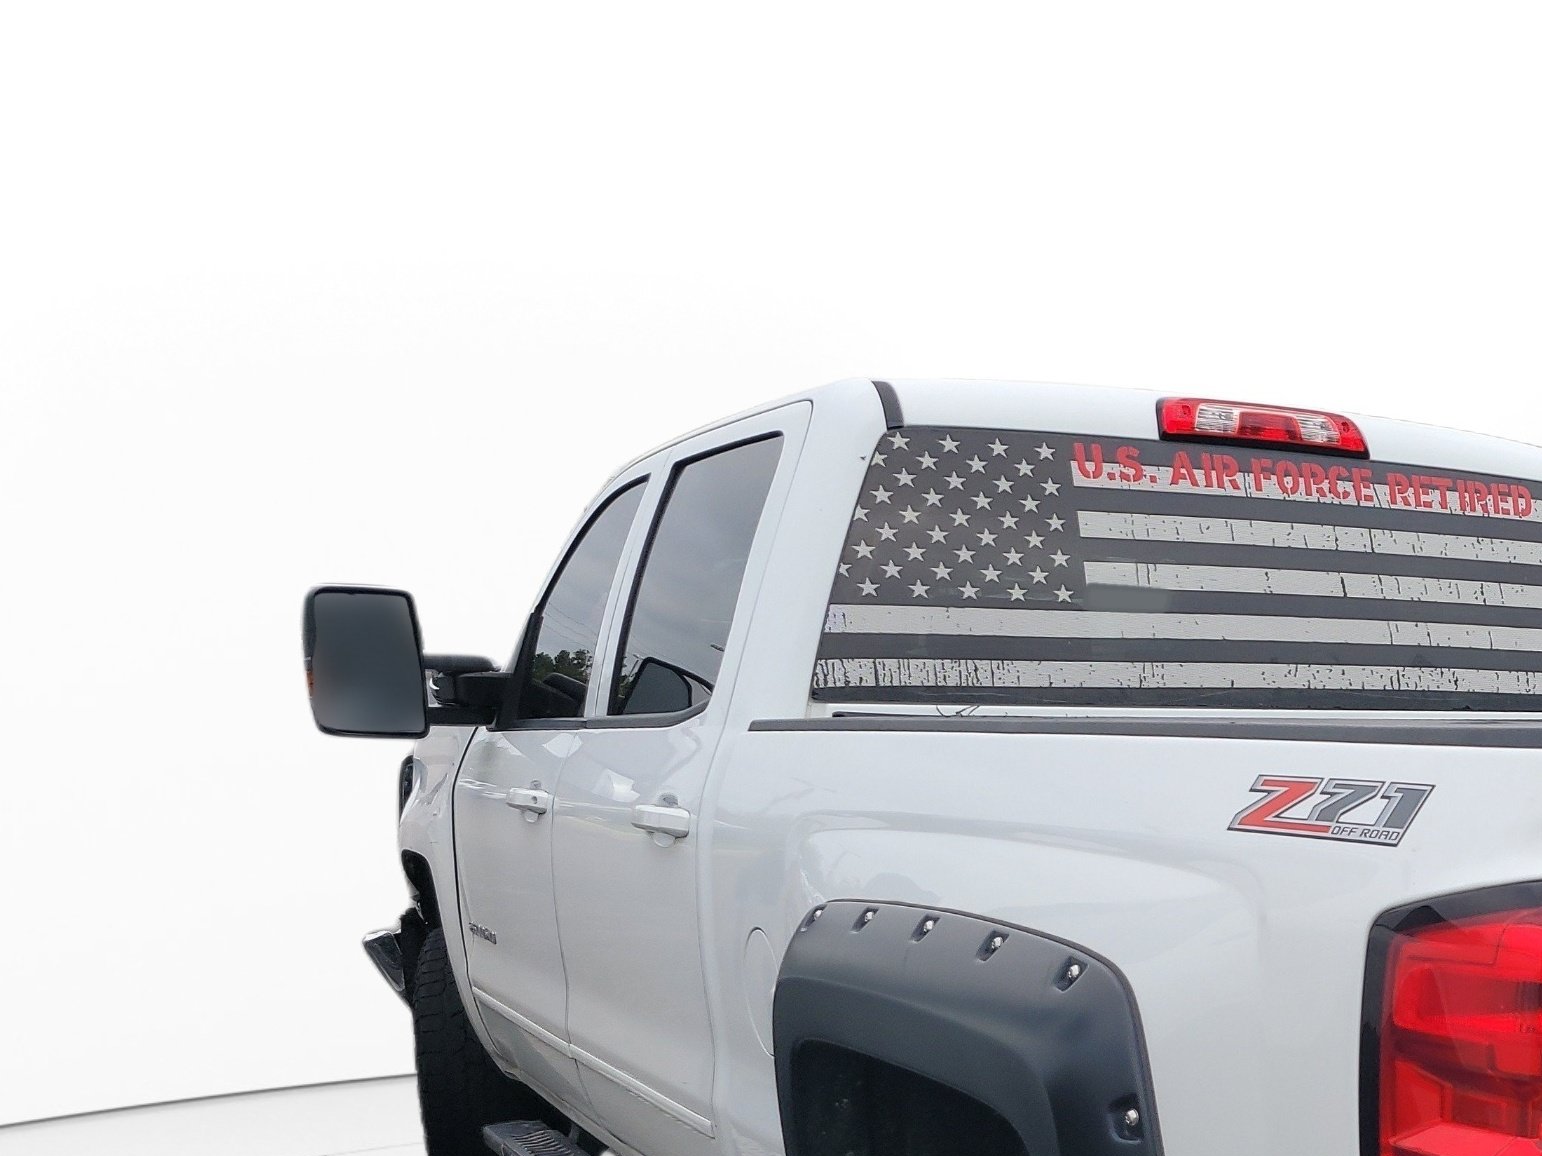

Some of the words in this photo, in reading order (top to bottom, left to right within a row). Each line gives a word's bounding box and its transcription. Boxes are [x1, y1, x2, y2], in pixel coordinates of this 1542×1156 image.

[1073, 441, 1158, 486] U.S.
[1169, 450, 1240, 491] AIR
[1251, 457, 1374, 505] FORCE
[1387, 472, 1534, 518] RETIRED
[1227, 774, 1436, 847] Z71
[1330, 825, 1359, 838] OFF
[1359, 828, 1401, 842] ROAD
